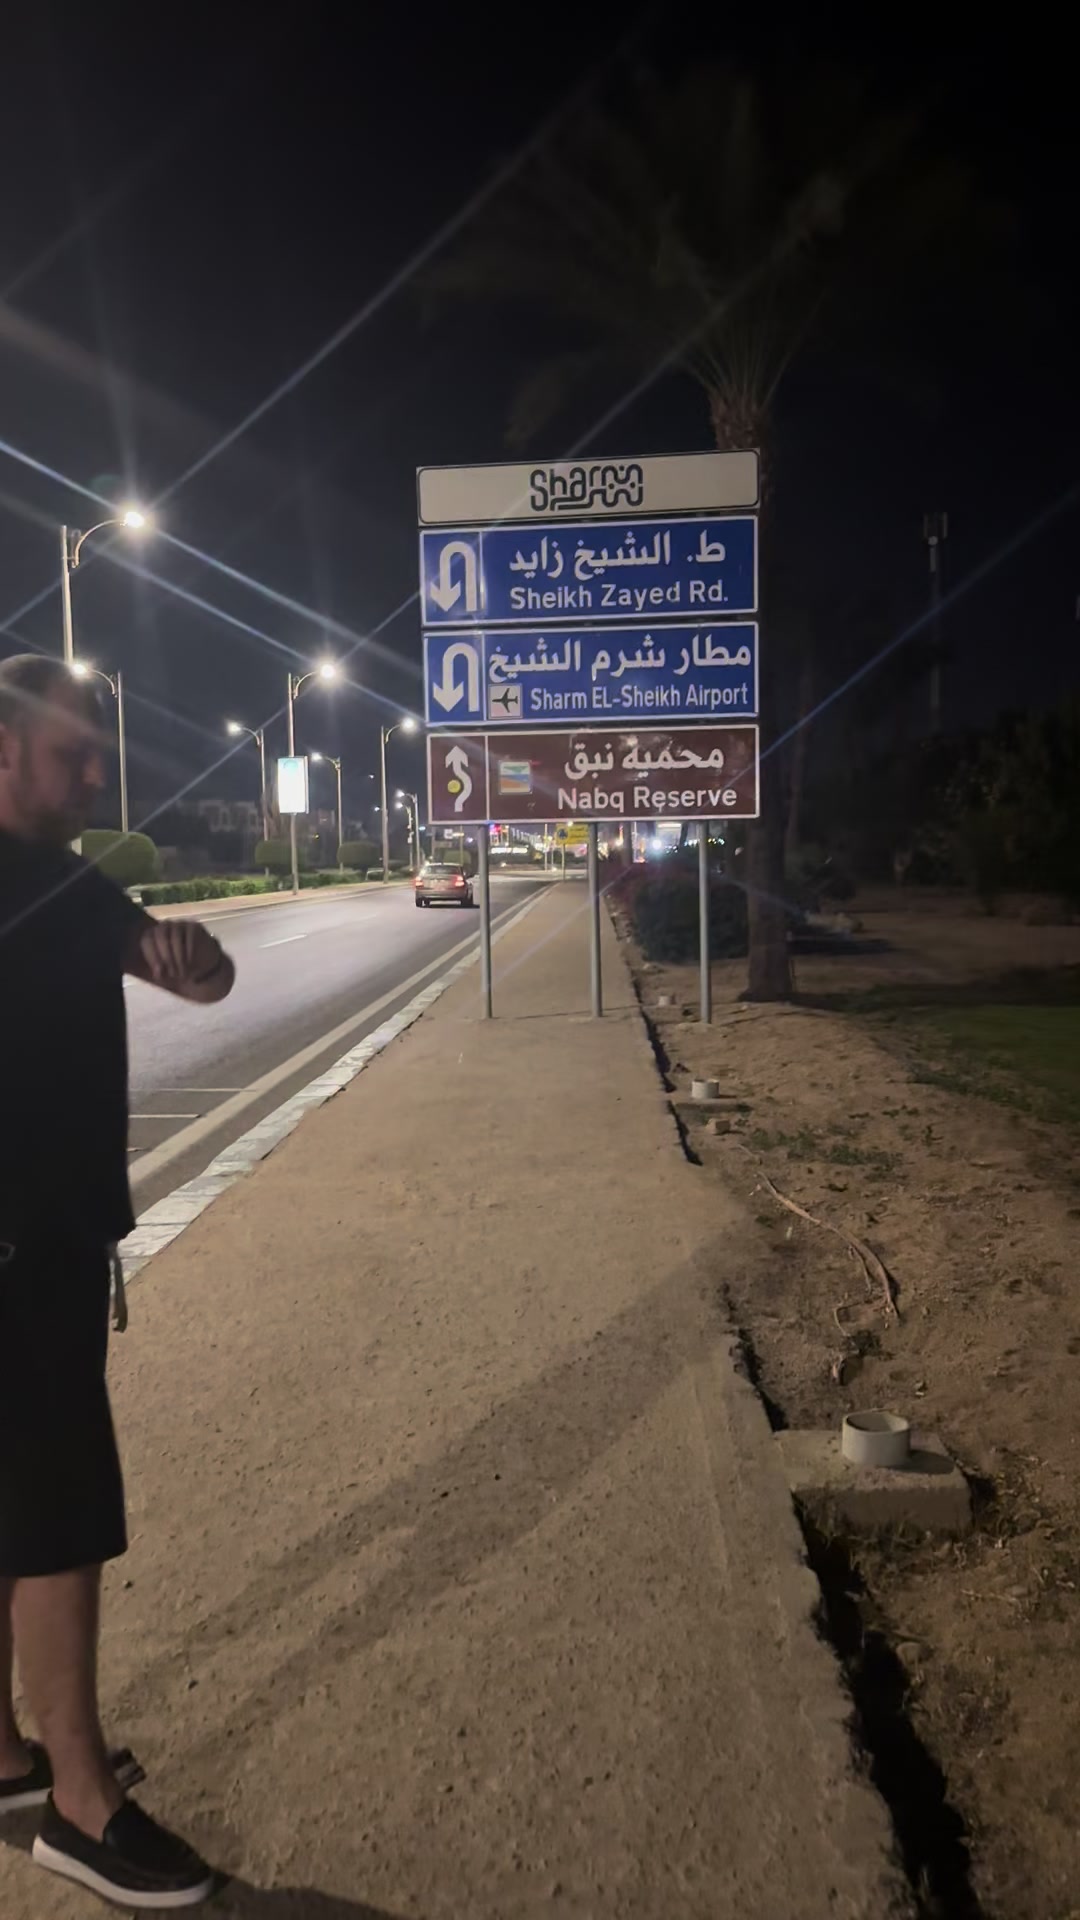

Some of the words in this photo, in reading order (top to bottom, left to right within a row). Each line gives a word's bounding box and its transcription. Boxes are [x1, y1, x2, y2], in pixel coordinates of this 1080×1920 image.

[509, 537, 564, 578] زايد
[573, 531, 670, 580] الشيخ
[686, 530, 726, 563] ط.
[510, 586, 592, 610] Sheikh
[601, 582, 680, 611] Zayed
[689, 580, 728, 602] Rd.
[488, 637, 581, 683] الشيخ
[591, 634, 666, 681] شرم
[673, 634, 751, 675] مطار
[530, 688, 587, 710] Sharm
[592, 685, 681, 708] EL-Sheikh
[686, 682, 748, 709] Airport
[564, 742, 614, 780] نبق
[558, 788, 624, 812] Nabq
[634, 786, 737, 808] Reserve
